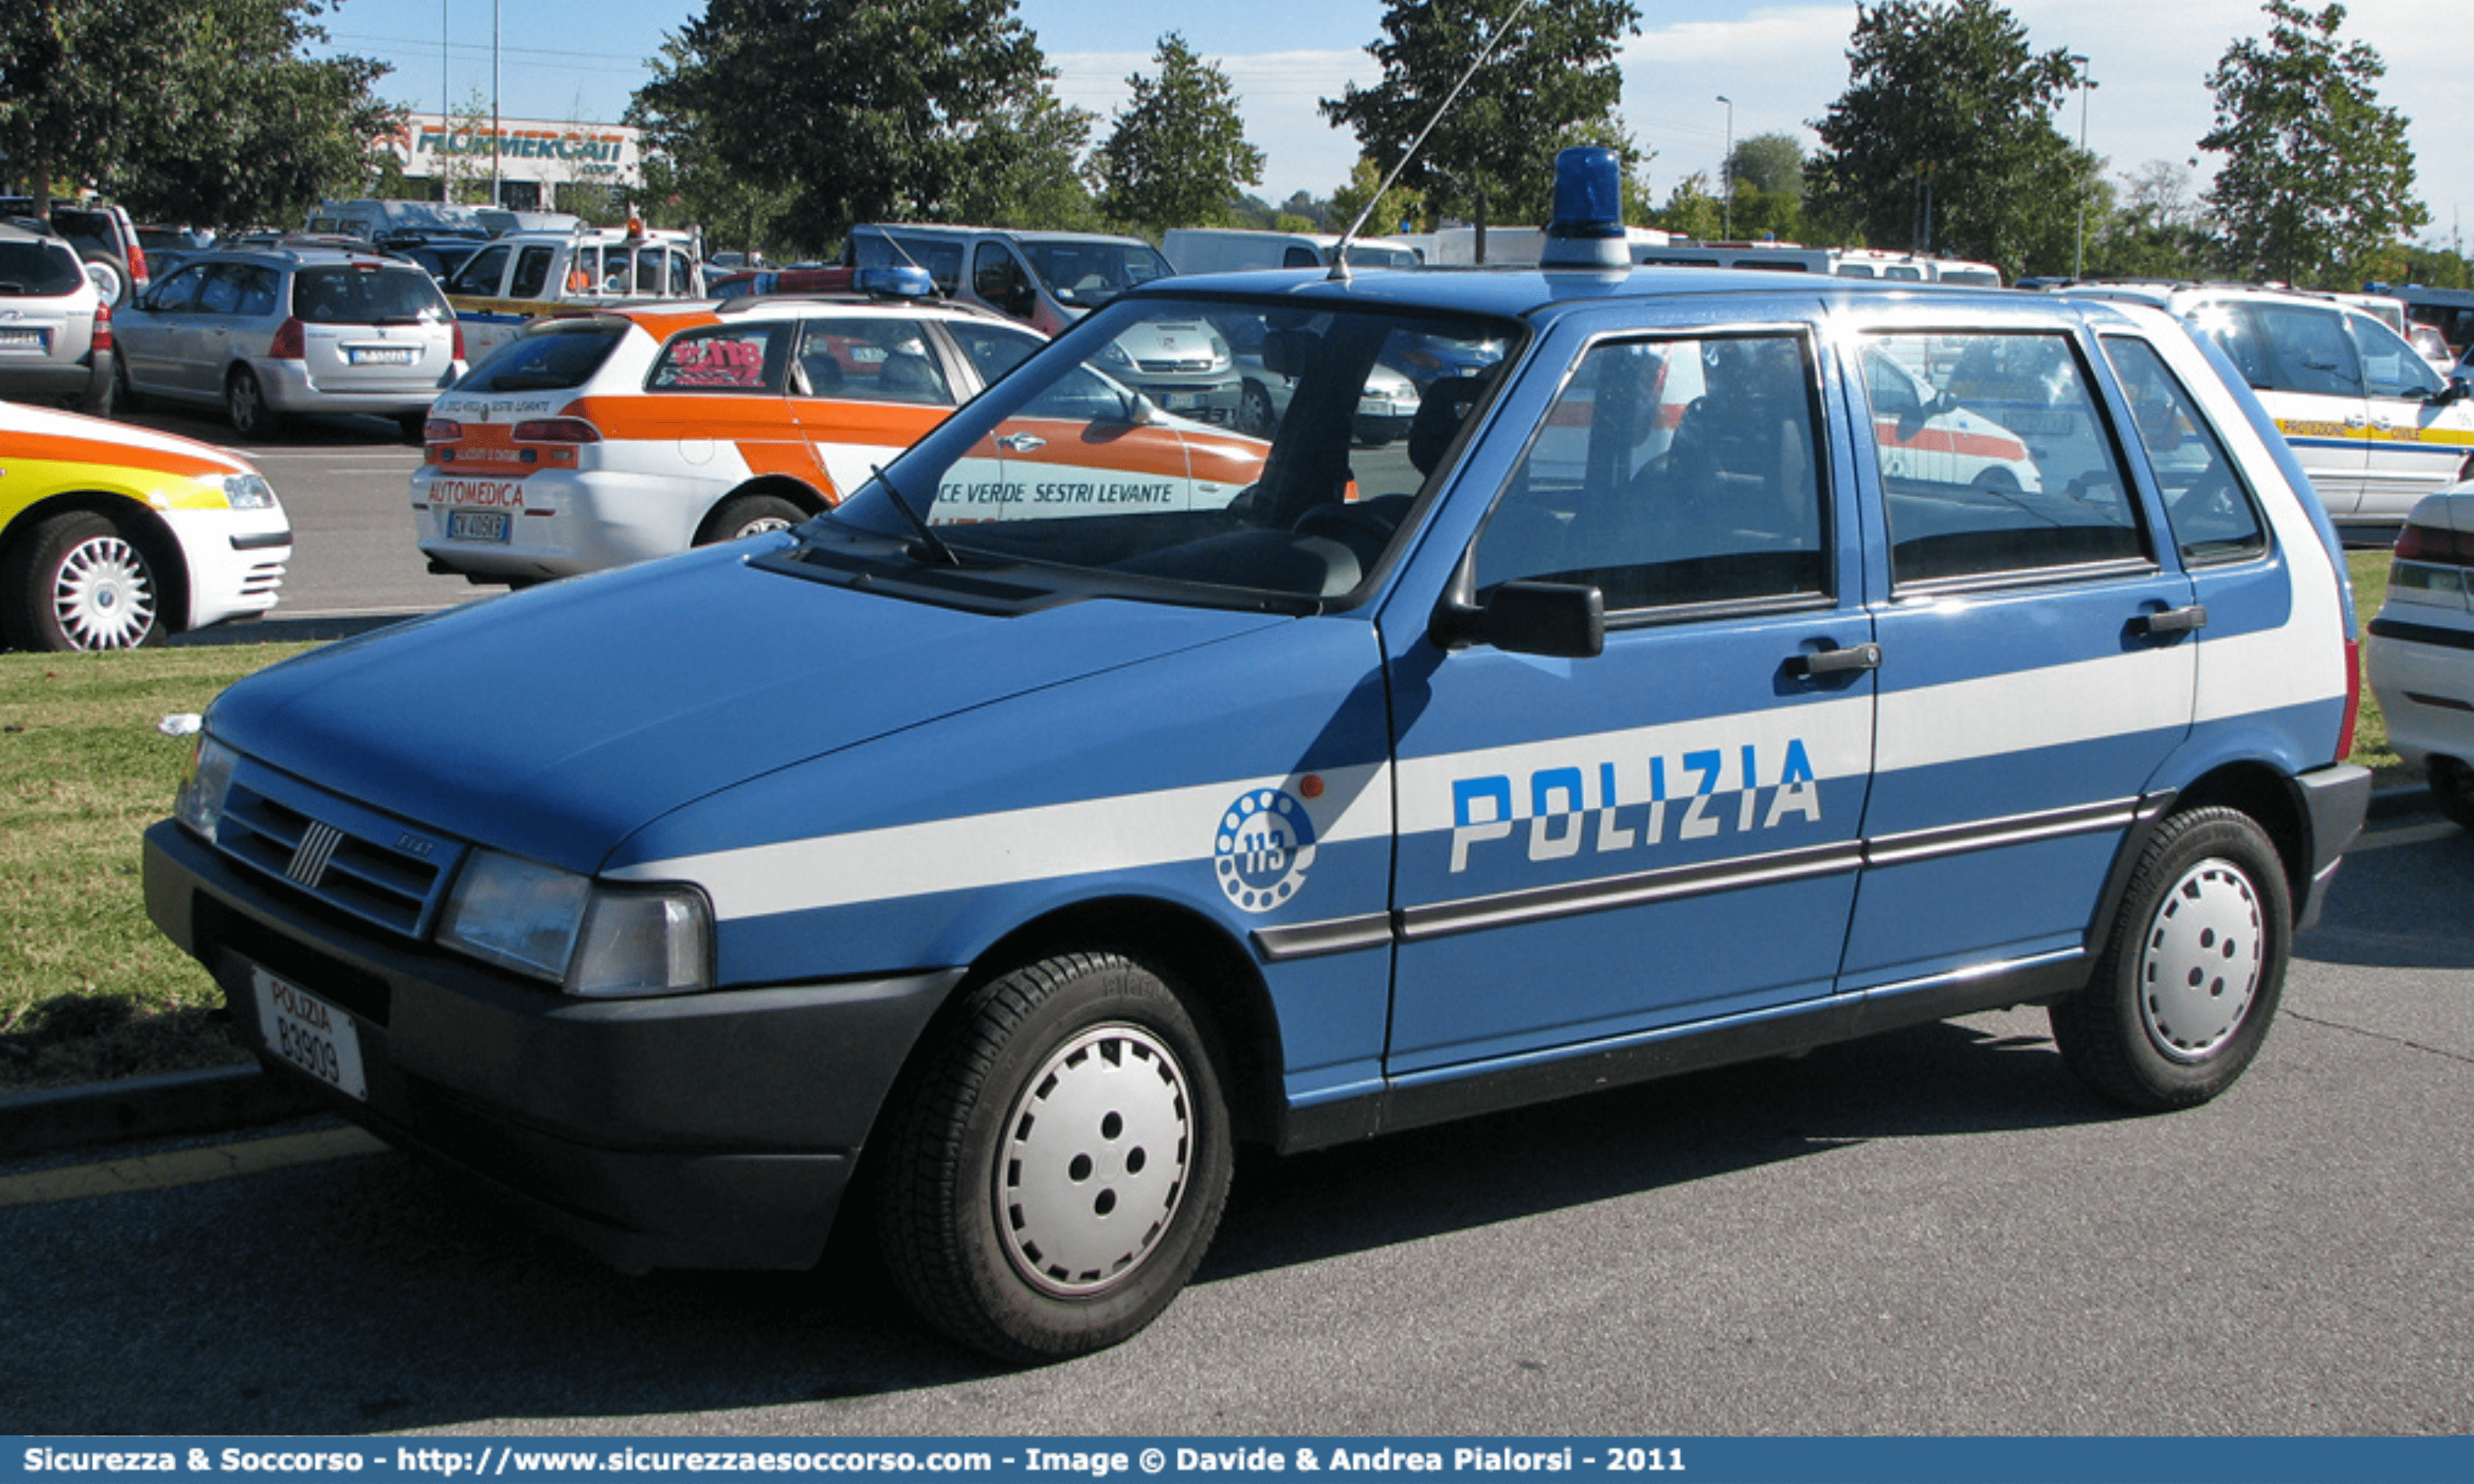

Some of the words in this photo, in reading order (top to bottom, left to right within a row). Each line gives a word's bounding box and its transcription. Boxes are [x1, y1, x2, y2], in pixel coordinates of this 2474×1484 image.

[429, 481, 524, 507] AUTOMEDICA
[967, 483, 1026, 503] VERDE
[1033, 483, 1094, 503] SESTRI
[1098, 483, 1174, 503] LEVANTE
[1449, 739, 1821, 874] POLIZIA
[1243, 829, 1285, 874] 113
[270, 980, 333, 1031] POLIZIA
[277, 1015, 340, 1082] B3909
